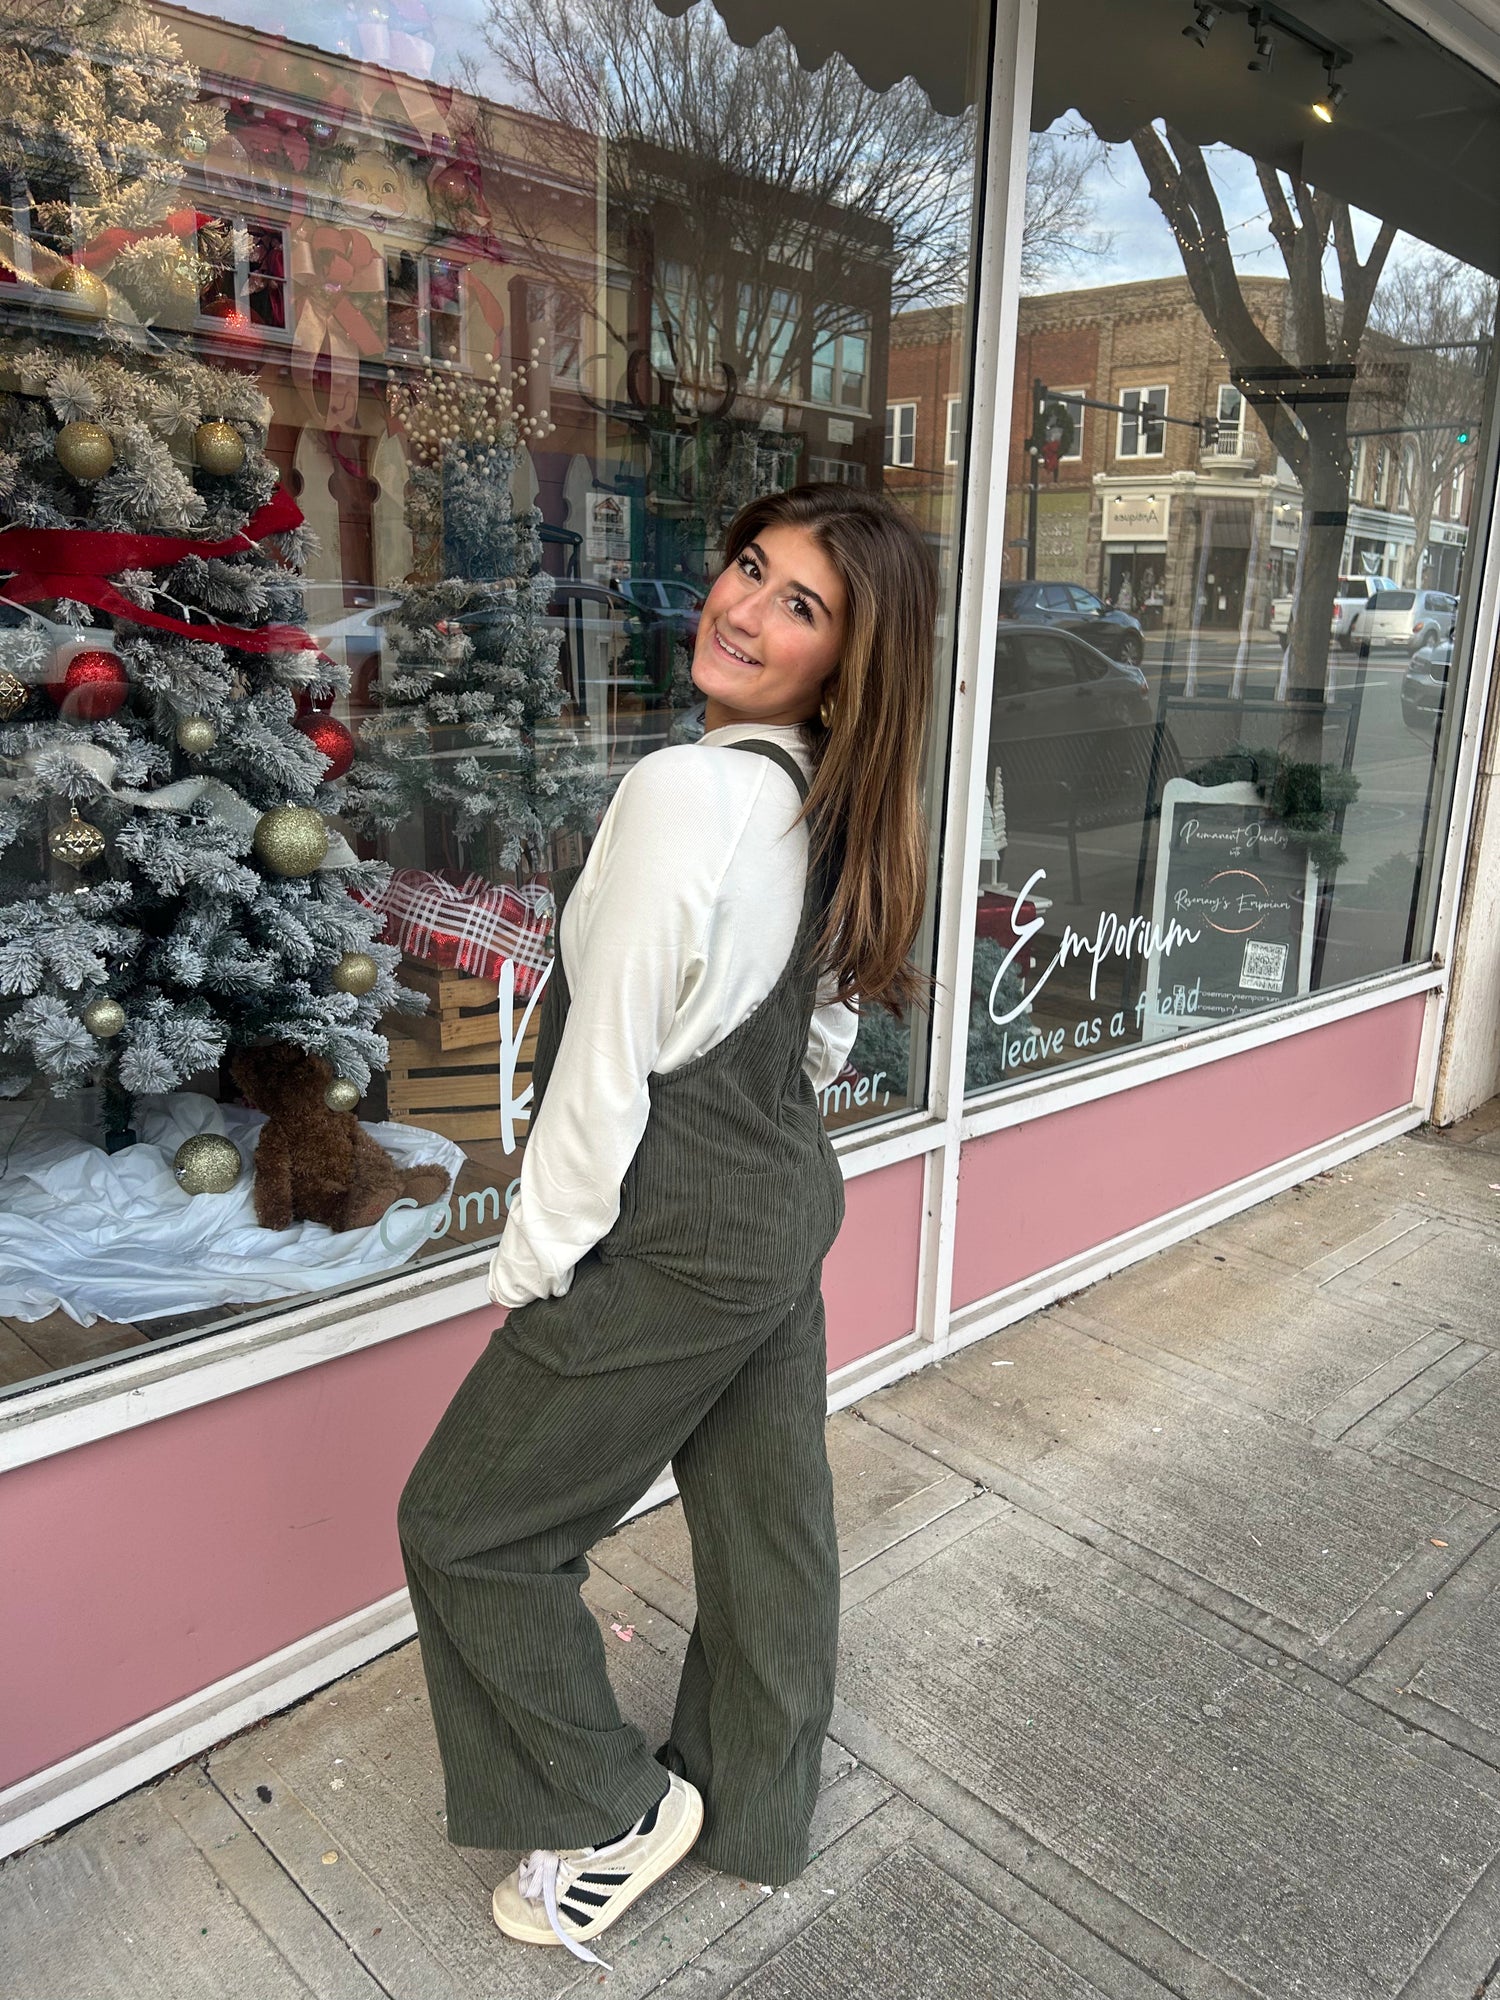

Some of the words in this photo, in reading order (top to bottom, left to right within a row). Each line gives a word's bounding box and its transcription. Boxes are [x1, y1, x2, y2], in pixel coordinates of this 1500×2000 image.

[1179, 818, 1246, 845] Permanent
[1244, 822, 1289, 851] Jewelry
[1174, 887, 1231, 913] Rosemary's
[988, 868, 1201, 1025] Emporium
[1240, 978, 1266, 990] SCAN
[1267, 982, 1282, 992] ME
[1001, 1026, 1066, 1071] leave
[1074, 1016, 1102, 1047] as
[1109, 1011, 1126, 1038] a
[1135, 976, 1201, 1029] fiend
